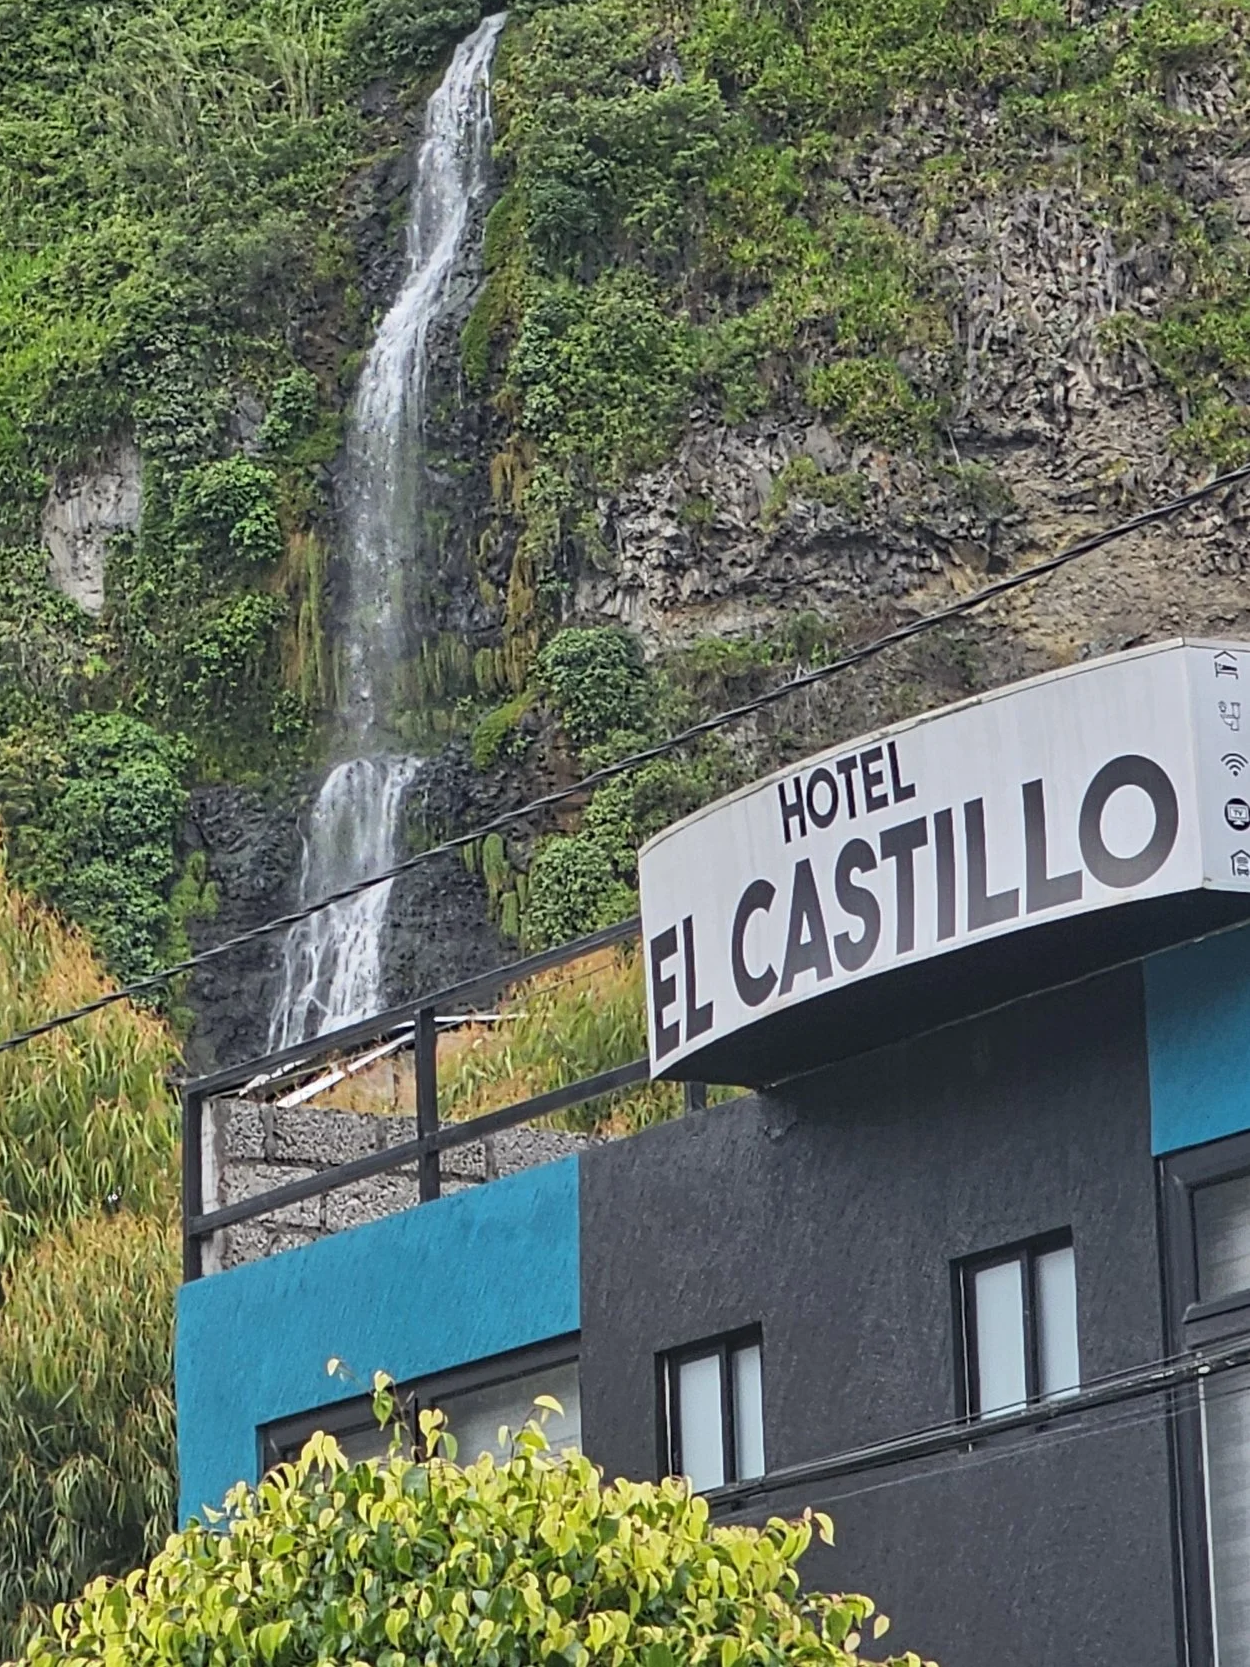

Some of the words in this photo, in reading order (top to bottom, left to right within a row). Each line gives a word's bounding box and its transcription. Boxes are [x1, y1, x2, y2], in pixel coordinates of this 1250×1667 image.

[778, 741, 915, 843] HOTEL
[650, 915, 714, 1062] EL
[731, 754, 1179, 1007] CASTILLO
